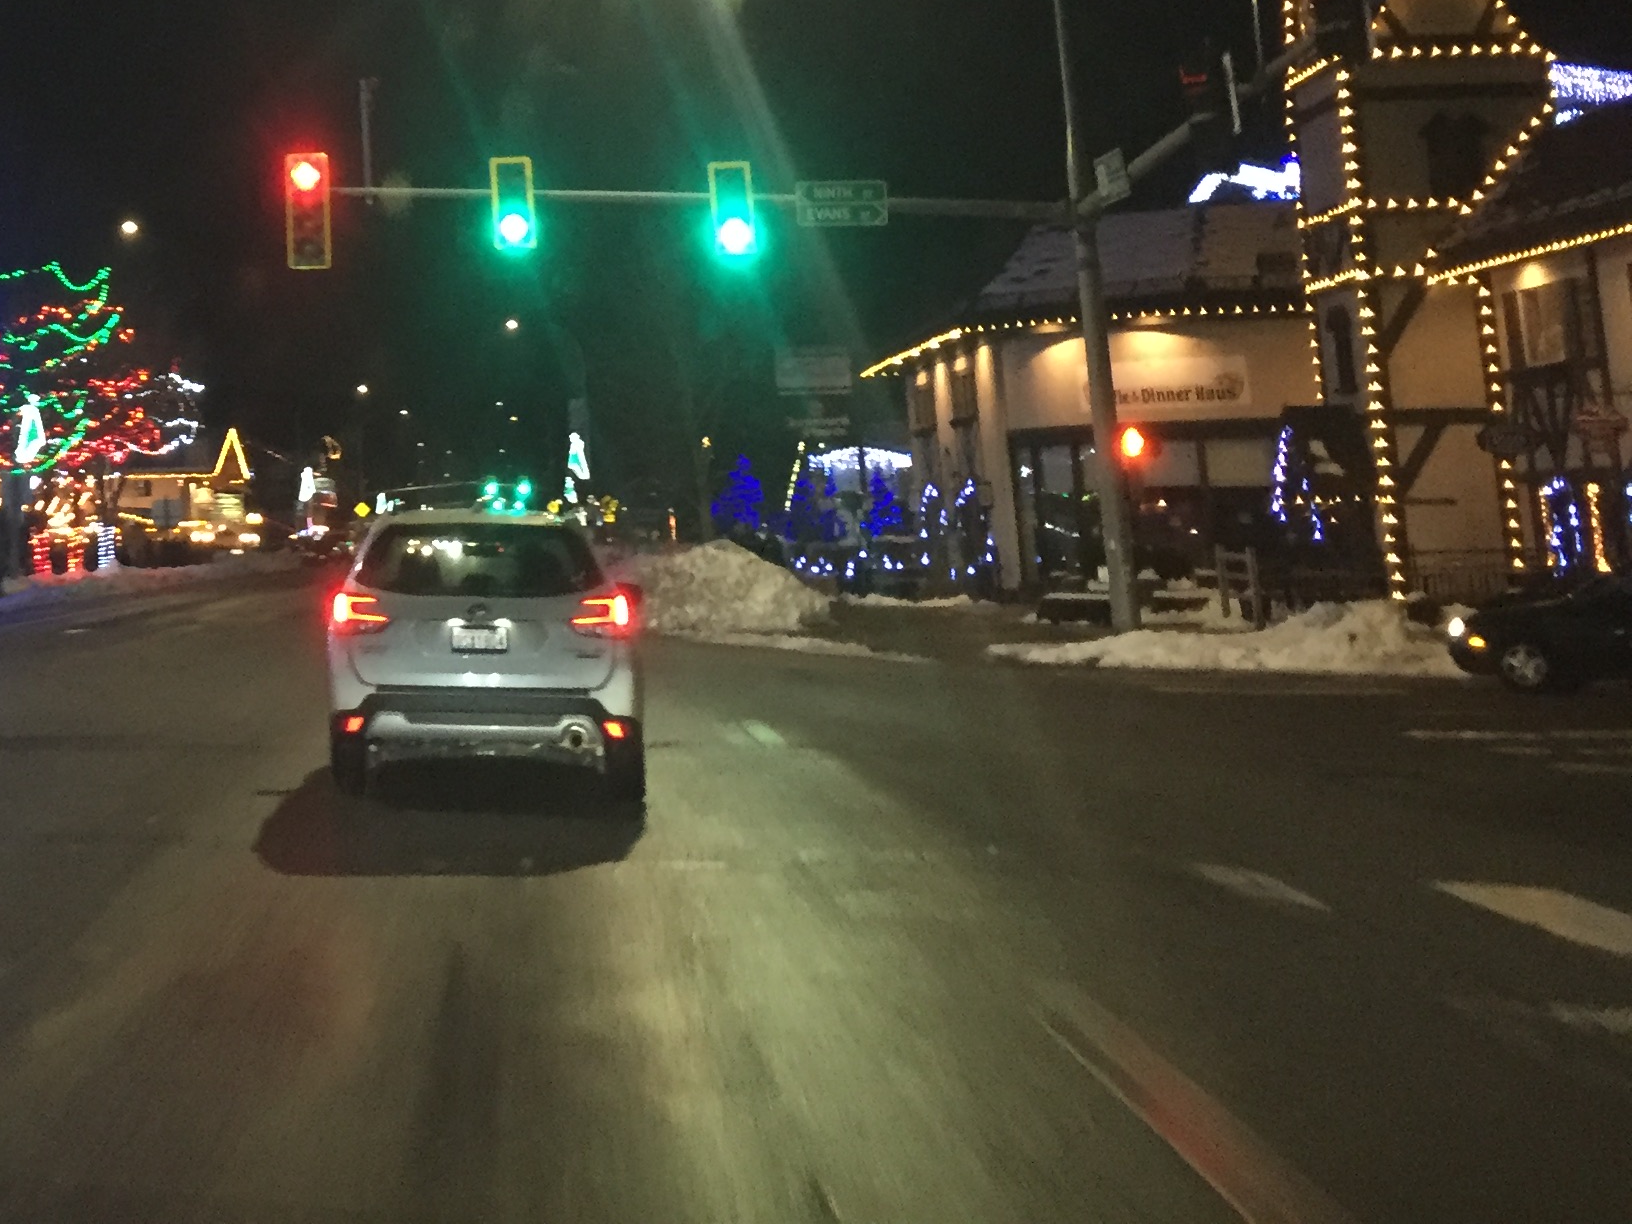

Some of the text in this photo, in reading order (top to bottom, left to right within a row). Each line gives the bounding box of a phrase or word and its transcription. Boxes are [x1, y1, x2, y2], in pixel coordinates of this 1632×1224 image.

[806, 207, 851, 220] EVANS
[1141, 387, 1192, 404] Dinner
[1195, 384, 1237, 401] Haus
